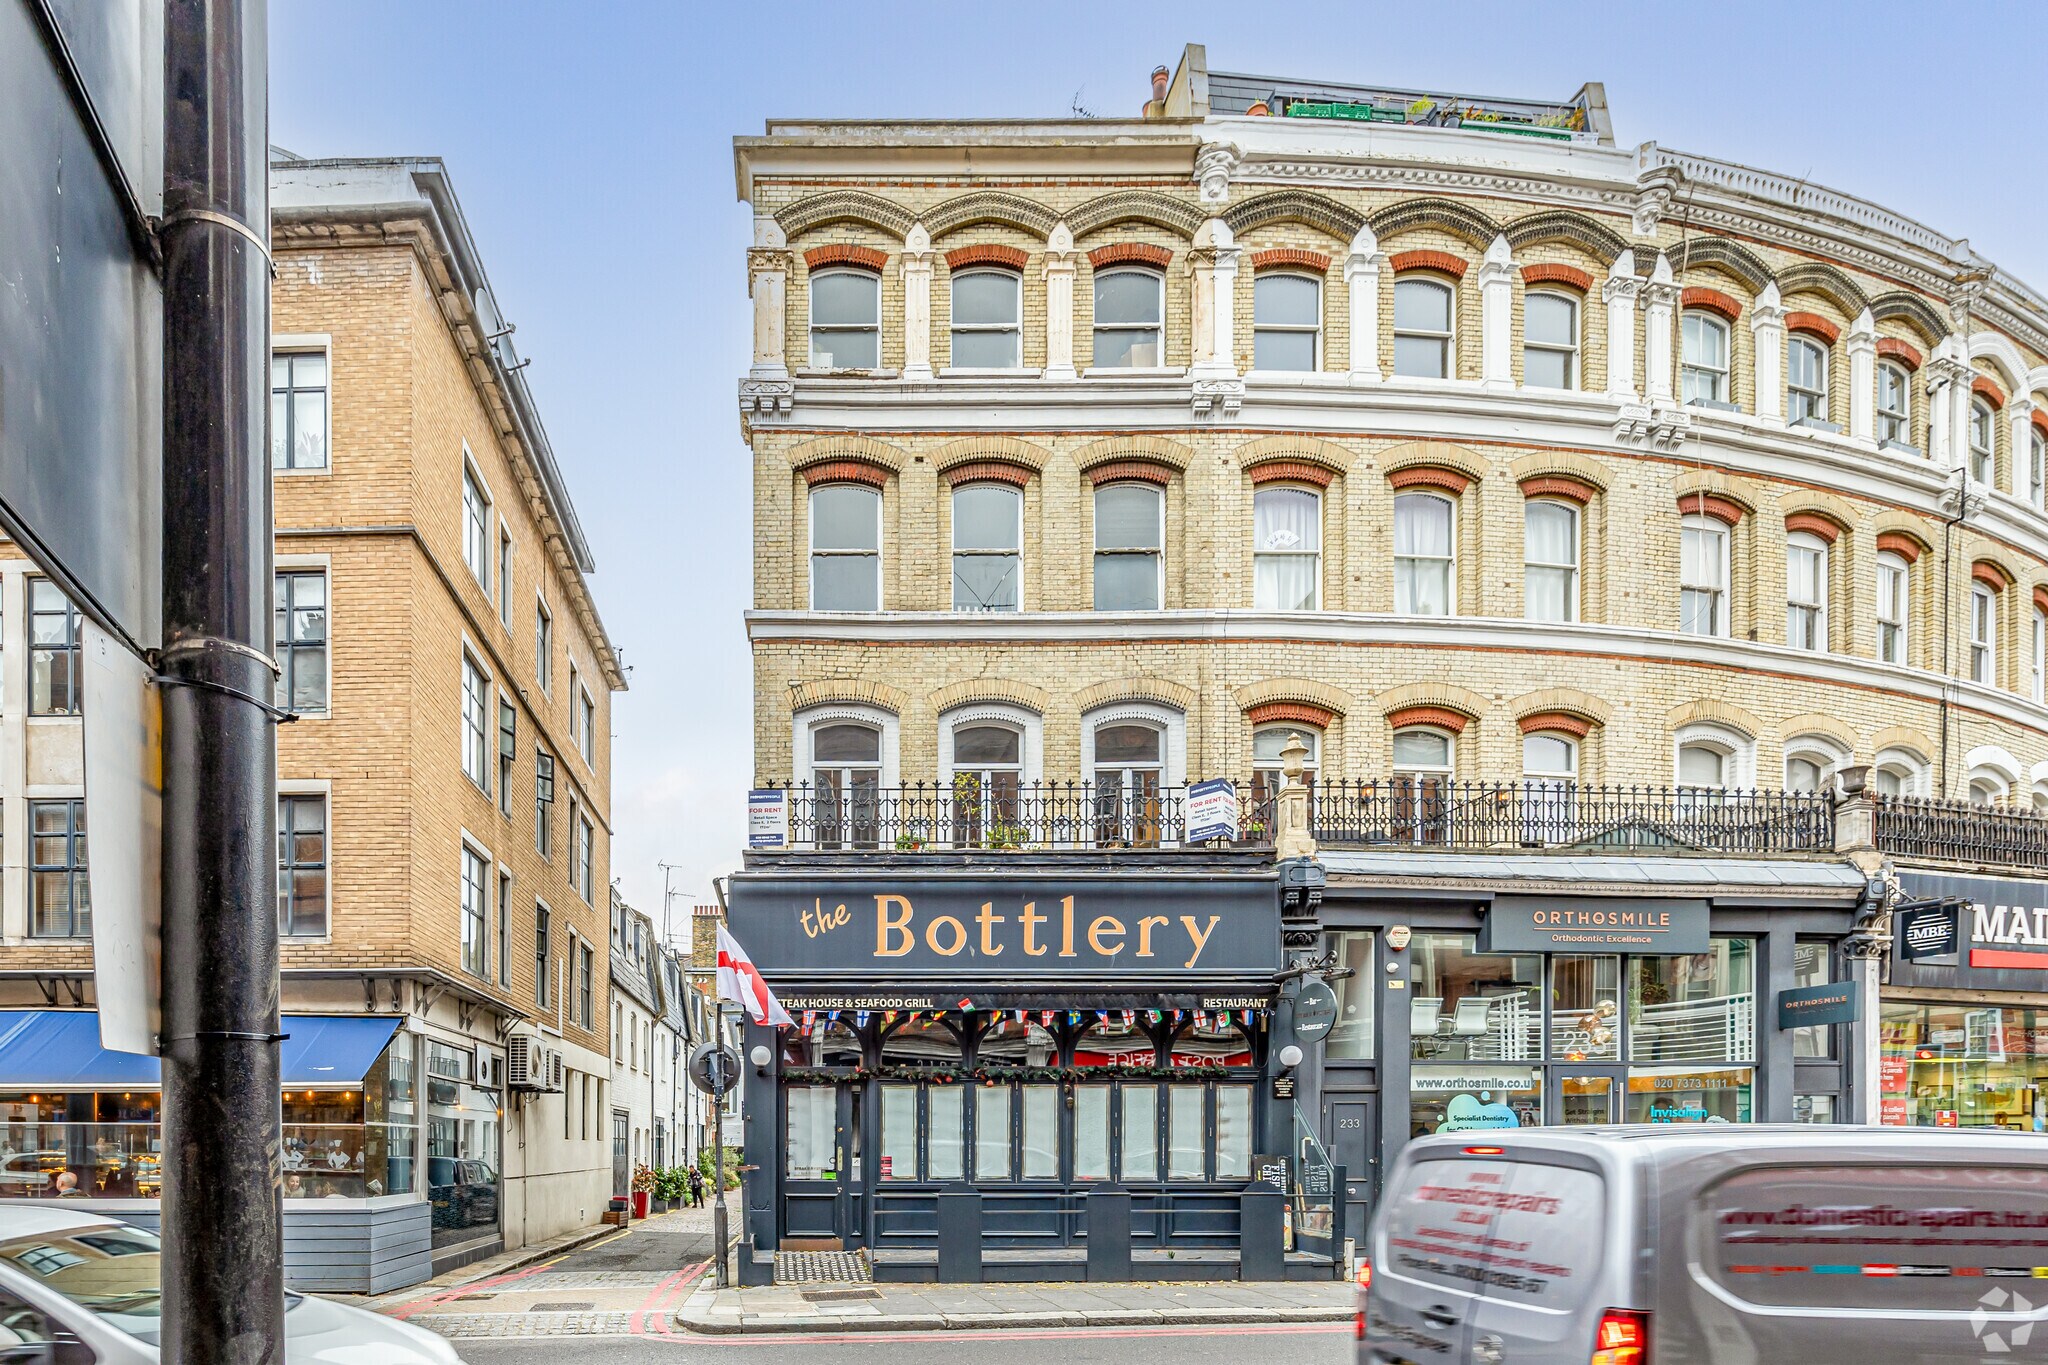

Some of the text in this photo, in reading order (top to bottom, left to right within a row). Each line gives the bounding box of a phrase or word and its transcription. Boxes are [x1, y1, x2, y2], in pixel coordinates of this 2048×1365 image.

[1190, 801, 1203, 809] FOR
[1204, 796, 1222, 805] RENT
[1533, 910, 1671, 927] ORTHOSMILE
[1971, 903, 2048, 945] MAI
[800, 894, 1221, 969] the Bottlery
[1913, 924, 1948, 940] MBE
[1551, 933, 1652, 944] Orthodontic Excellence
[779, 998, 934, 1008] TEAK HOUSE & SEAFOOD GRILL
[1203, 998, 1268, 1008] RESTAURANT
[1309, 997, 1317, 1006] Bar
[1785, 995, 1848, 1009] ORTHOSMILE
[1301, 1022, 1323, 1032] Restaurant
[1415, 1077, 1537, 1089] www.orthosmile.co.uk
[1654, 1078, 1727, 1089] 020 7373 1111
[1453, 1114, 1510, 1122] Specialist Dentistry
[1650, 1104, 1708, 1121] Invisalign
[1340, 1119, 1360, 1129] 233
